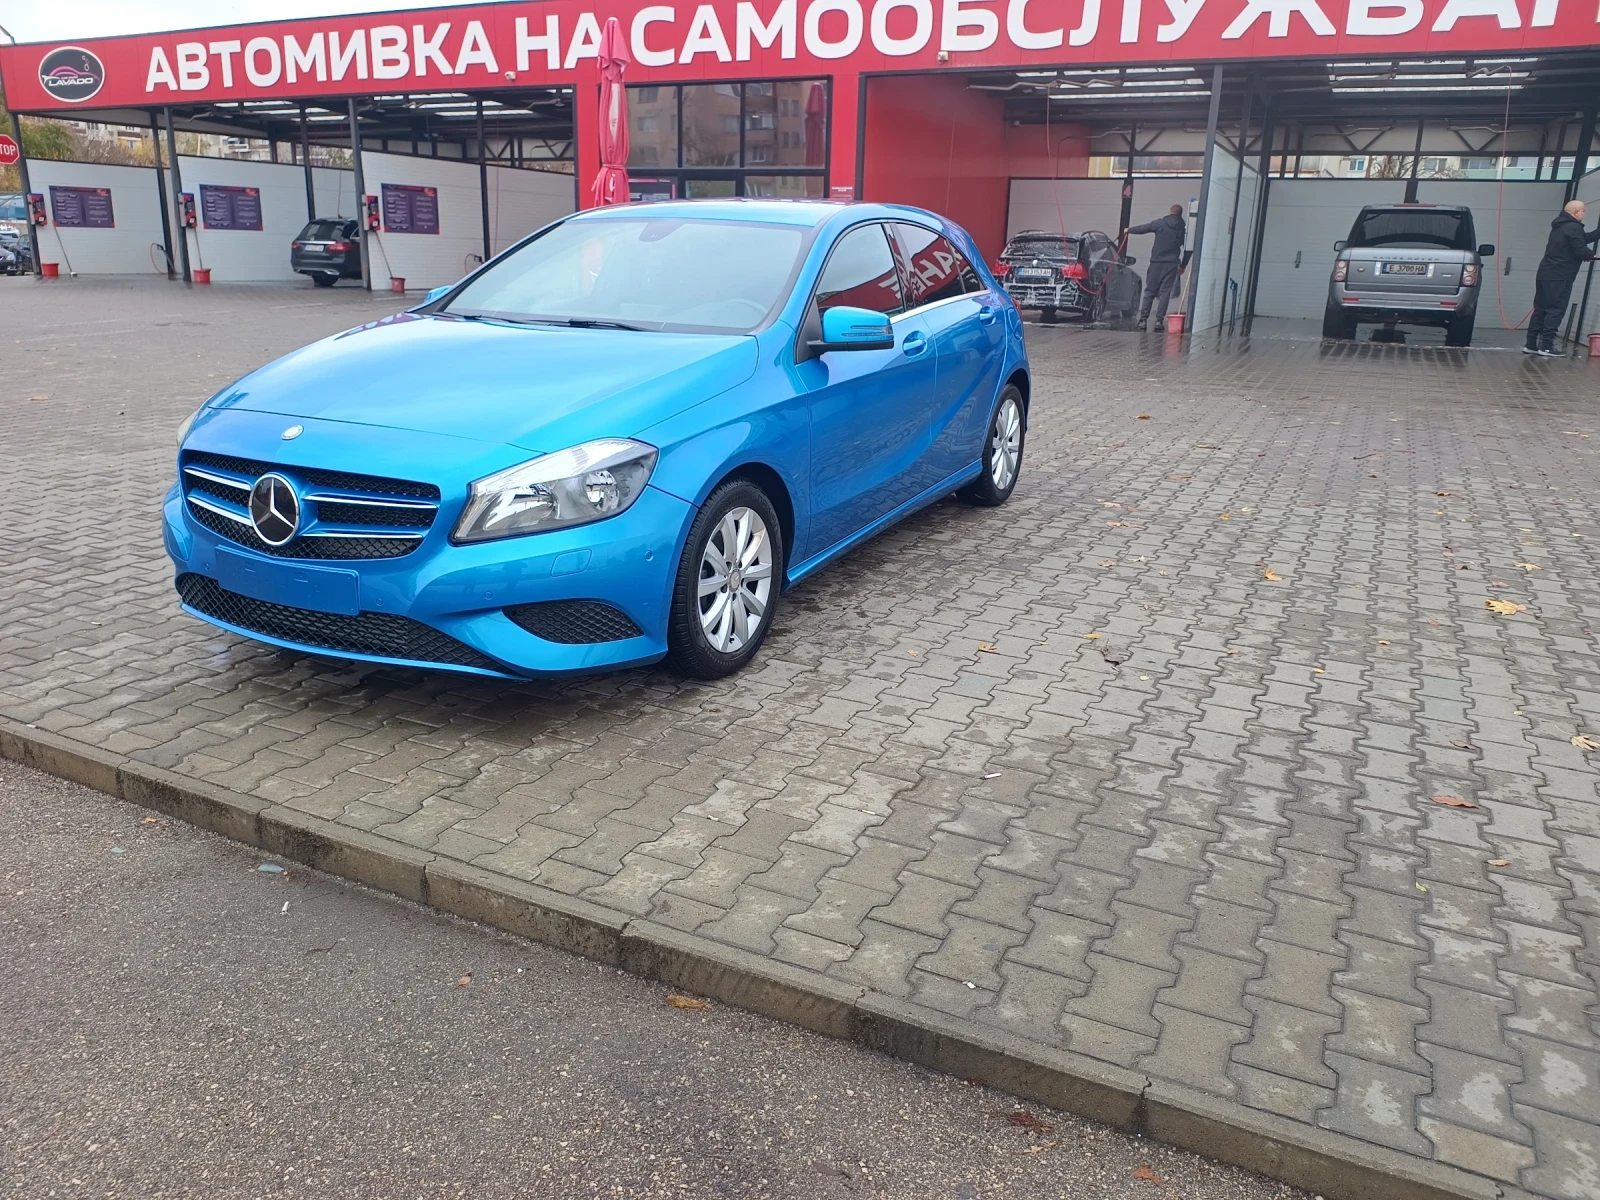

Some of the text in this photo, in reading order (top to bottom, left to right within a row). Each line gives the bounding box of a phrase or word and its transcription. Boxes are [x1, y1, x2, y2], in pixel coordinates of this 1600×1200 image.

[145, 20, 499, 92] АВТОМИВКА
[515, 12, 602, 72] НА
[48, 77, 94, 87] LAVADO
[1397, 265, 1414, 273] 3700
